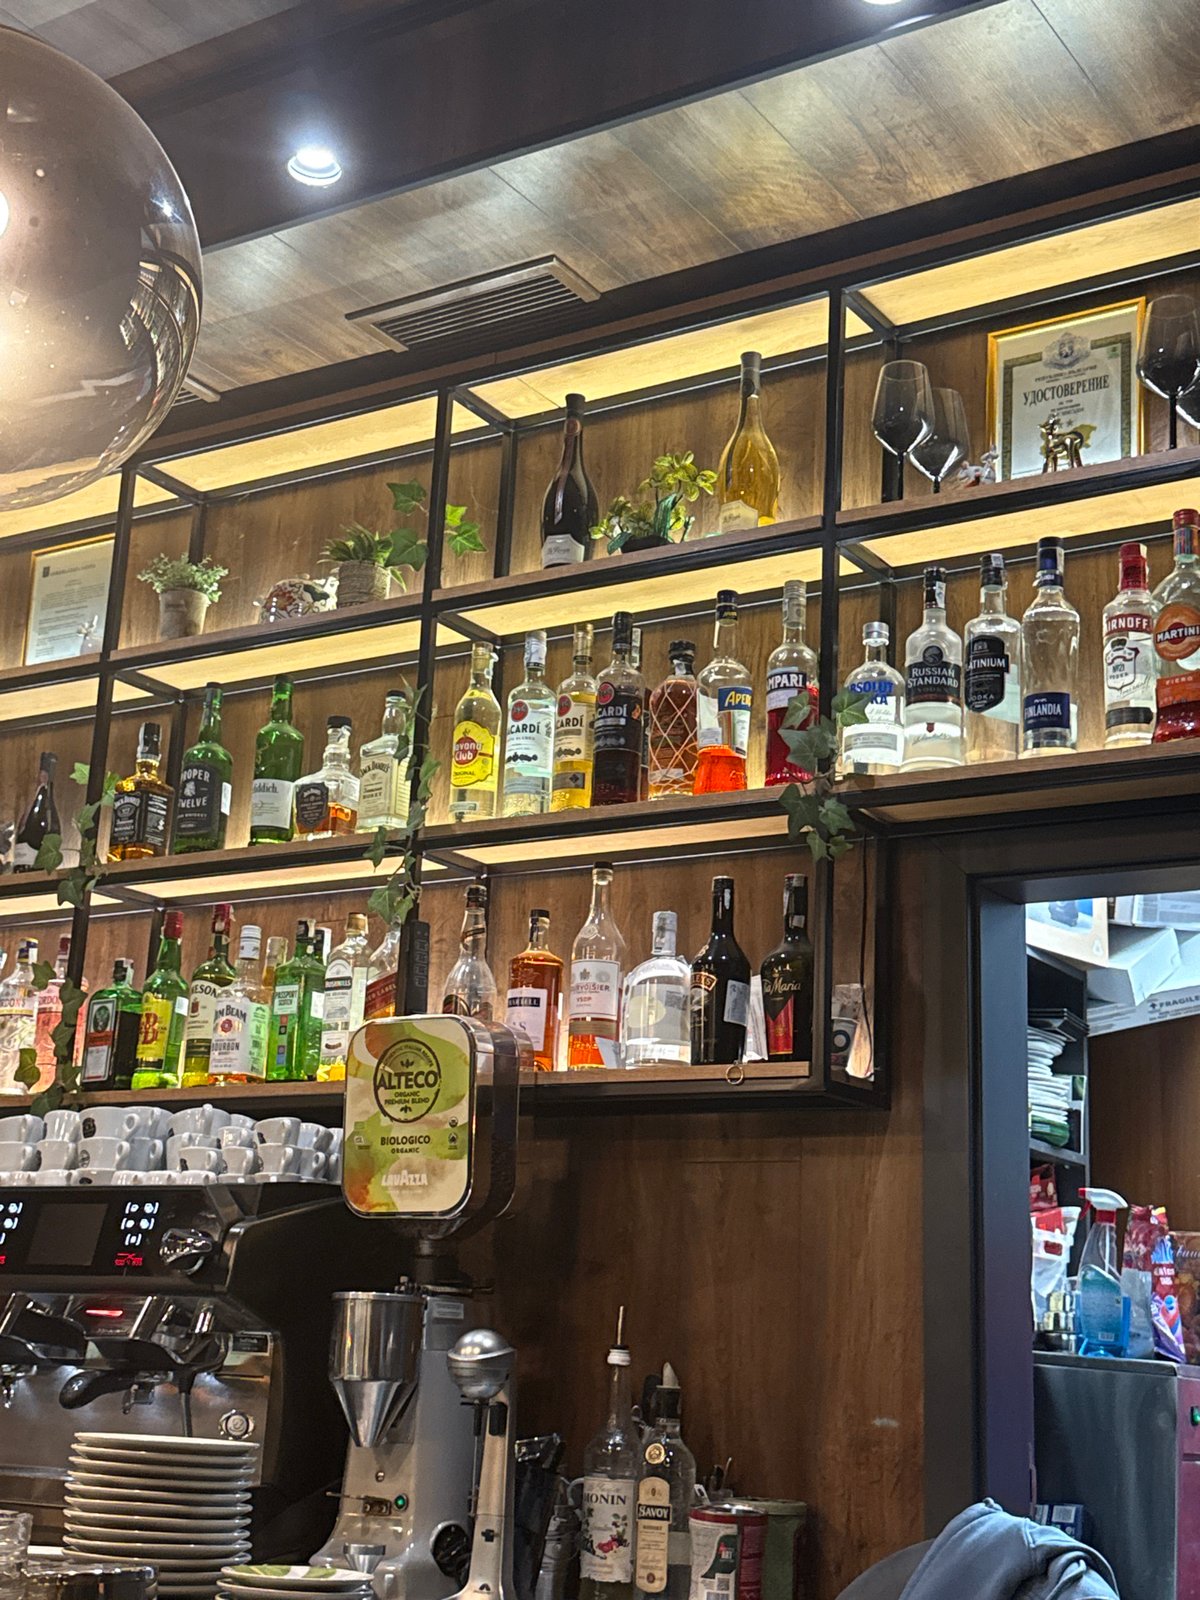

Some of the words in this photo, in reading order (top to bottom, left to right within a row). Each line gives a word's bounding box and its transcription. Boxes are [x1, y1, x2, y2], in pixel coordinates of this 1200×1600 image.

[1023, 374, 1110, 407] УДОСТОВЕРЕНИЕ
[1156, 625, 1200, 642] MARTINI
[912, 667, 956, 678] RUSSIAN
[767, 673, 804, 690] MPARI
[907, 676, 959, 689] STANDARD
[1165, 676, 1193, 686] FIERO
[597, 704, 628, 718] CARDÍ
[1024, 703, 1062, 719] FINLANDIA
[455, 750, 474, 760] Club
[769, 977, 801, 995] Maria
[1159, 994, 1200, 1008] FRAGILE
[225, 1004, 247, 1022] BEAM
[377, 1070, 438, 1090] ALTECO
[394, 1090, 420, 1098] ORGANIC
[380, 1135, 431, 1146] BIOLOGICO
[381, 1169, 429, 1186] LAVAZZA
[638, 1506, 669, 1519] SAVOY
